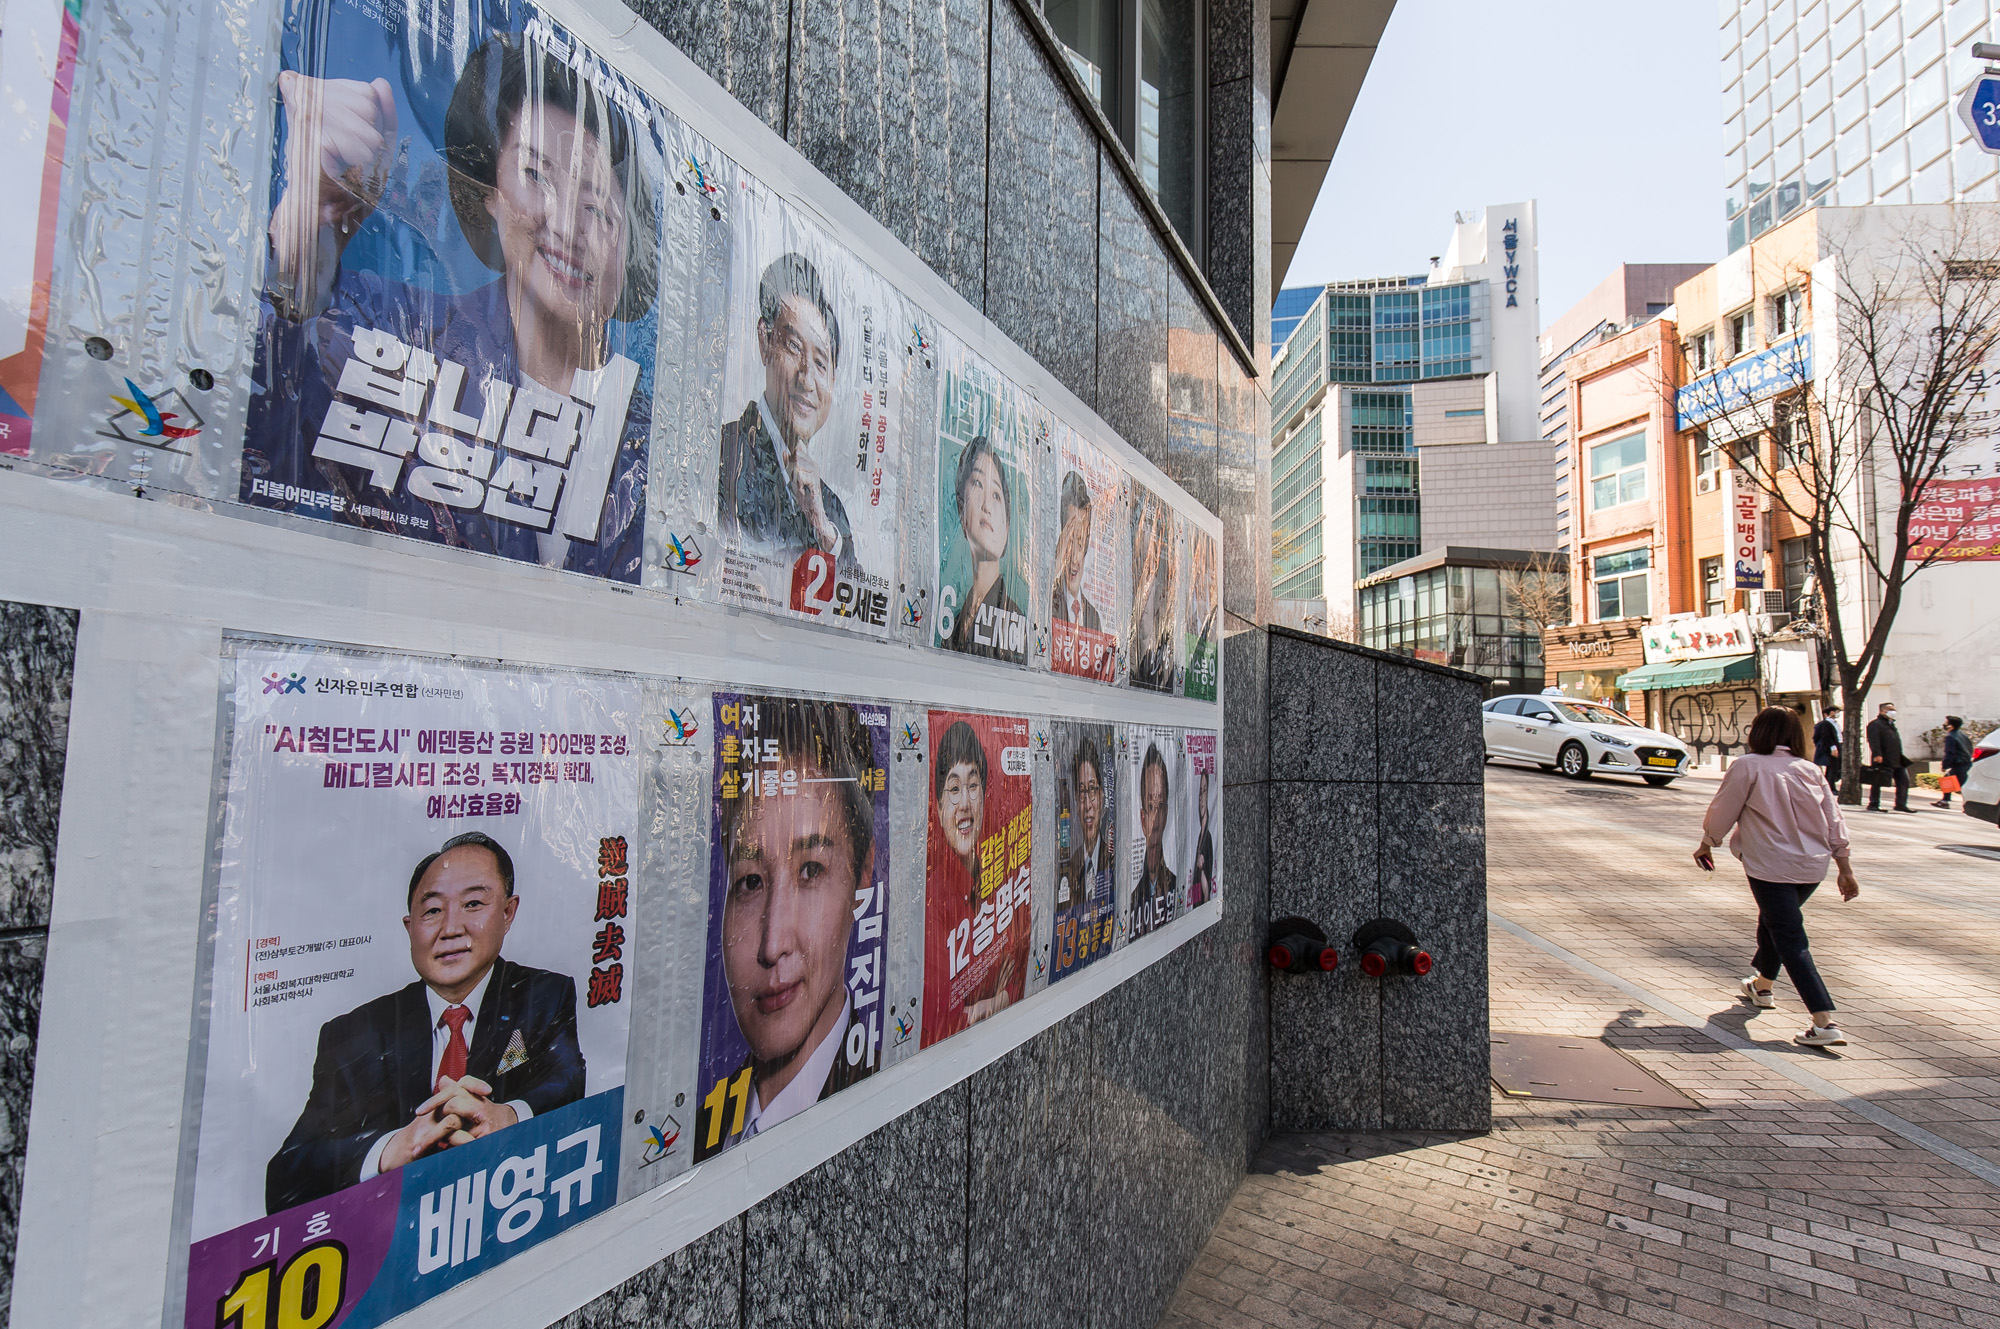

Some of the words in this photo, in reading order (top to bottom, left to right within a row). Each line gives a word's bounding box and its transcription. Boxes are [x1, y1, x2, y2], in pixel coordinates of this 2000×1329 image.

[1502, 217, 1519, 308] 서울YWCA
[856, 390, 873, 472] 능숙하게
[252, 477, 347, 513] 더불어민주당
[350, 502, 409, 526] 서울특별시장
[410, 516, 429, 530] 후보
[1736, 494, 1757, 562] 골뱅이
[1909, 525, 1949, 541] 40년
[805, 554, 828, 610] 2
[833, 582, 888, 628] 오세훈
[839, 565, 890, 590] 서울특별시장후보
[937, 585, 957, 640] 6
[1569, 641, 1611, 655] Nomu
[1209, 658, 1216, 686] 9
[314, 677, 419, 699] 신자유민주연합
[421, 688, 464, 700] (신자민련)
[720, 702, 761, 732] 여자
[859, 712, 887, 727] 여성의당
[265, 725, 411, 754] "AI첨단도시"
[418, 729, 495, 755] 에덴동산
[500, 731, 534, 755] 공원
[539, 732, 596, 755] 100만평
[600, 735, 630, 757] 조성,
[720, 734, 781, 764] 혼자도
[323, 762, 436, 789] 메디컬시티
[443, 762, 486, 787] 조성,
[492, 762, 559, 785] 복지정책
[563, 761, 595, 784] 확대,
[719, 769, 799, 799] 살기좋은
[859, 767, 887, 792] 서울
[426, 792, 522, 819] 예산효율화
[981, 832, 1005, 870] 강남
[1007, 802, 1032, 846] 해체!
[981, 856, 1005, 900] 평등
[1007, 831, 1032, 872] 서울!
[946, 917, 971, 981] 12
[972, 864, 1031, 957] 송명숙
[1129, 906, 1142, 939] 14
[255, 940, 337, 962] (전)삼부토건개발(주)
[339, 935, 372, 948] 대표이사
[256, 936, 281, 949] [경력]
[1055, 917, 1078, 973] 13
[1077, 915, 1114, 959] 정동희
[253, 968, 355, 996] 서울사회복지대학원대학교
[254, 969, 278, 983] [학력]
[845, 880, 884, 1069] 김진아
[252, 987, 313, 1008] 사회복지학석사
[704, 1066, 753, 1150] 11
[417, 1123, 603, 1276] 배영규
[251, 1210, 332, 1259] 기호
[217, 1240, 348, 1329] 10
